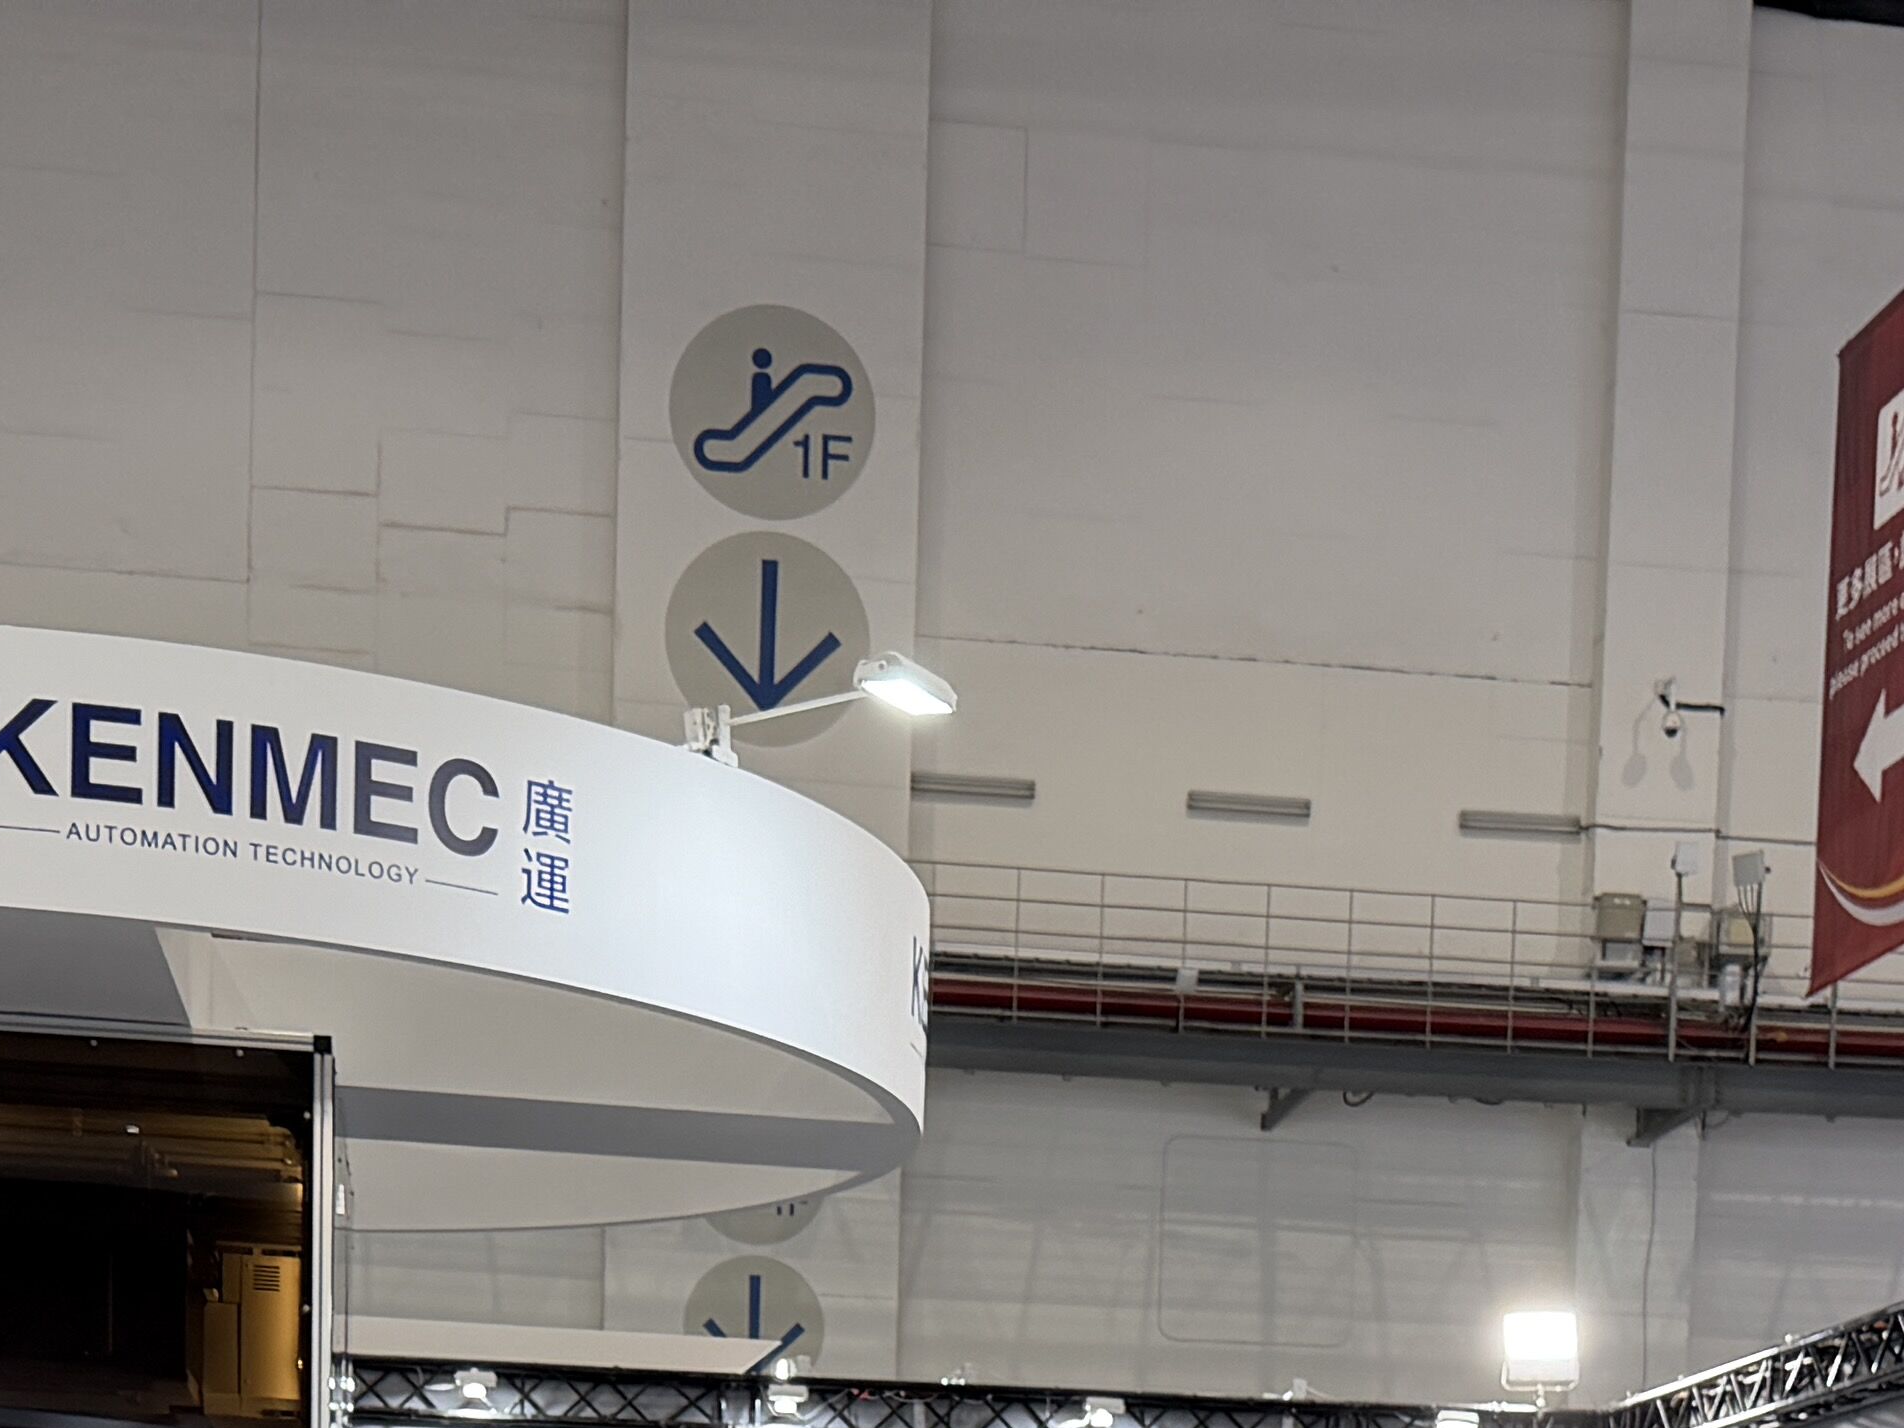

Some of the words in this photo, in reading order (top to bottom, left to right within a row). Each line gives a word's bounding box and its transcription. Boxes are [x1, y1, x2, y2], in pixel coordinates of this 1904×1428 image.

[793, 434, 852, 480] 1F
[66, 822, 238, 858] AUTOMATION
[249, 842, 419, 885] TECHNOLOGY
[521, 779, 573, 914] 廣運
